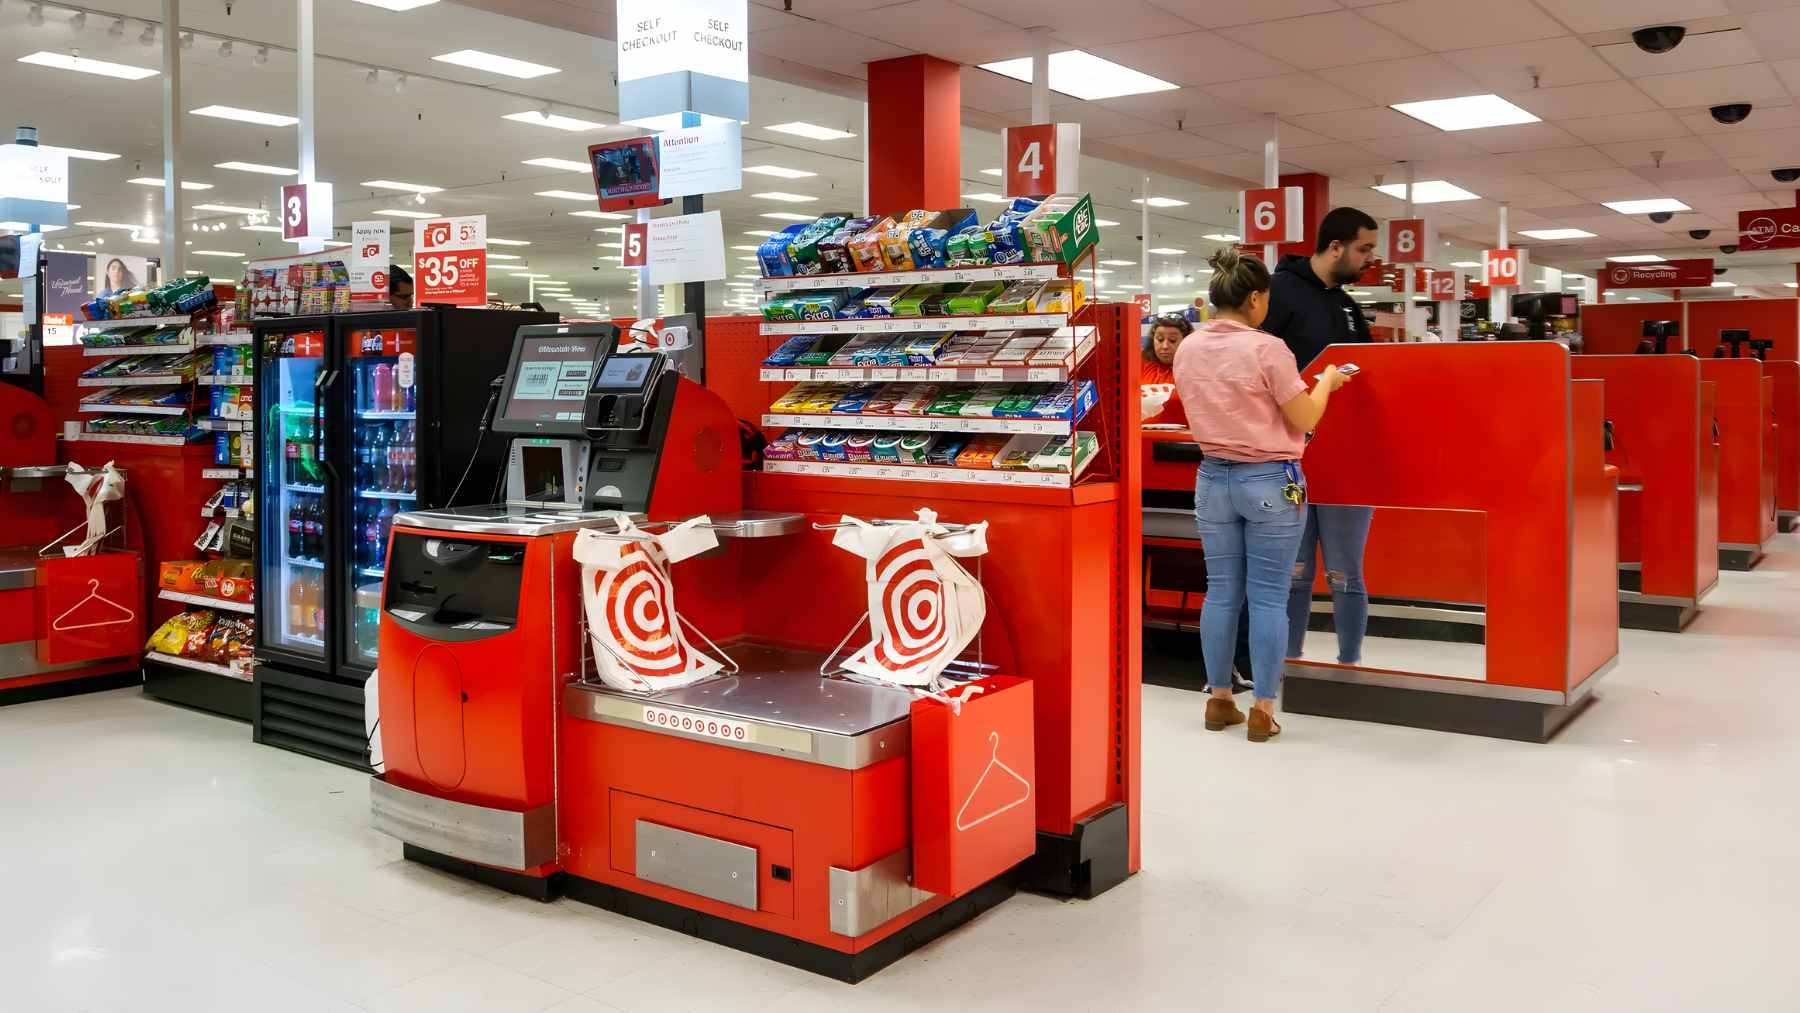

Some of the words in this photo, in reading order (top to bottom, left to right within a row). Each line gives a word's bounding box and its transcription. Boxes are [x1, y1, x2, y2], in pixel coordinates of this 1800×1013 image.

[637, 17, 661, 33] SELF
[707, 18, 729, 33] SELF
[622, 30, 677, 52] CHECKOUT
[693, 31, 743, 52] CHECKOUT
[663, 135, 699, 148] Attention
[1018, 141, 1044, 180] 4
[288, 196, 301, 227] 3
[1255, 201, 1276, 231] 6
[628, 233, 641, 257] 5
[1397, 229, 1415, 253] 8
[419, 255, 459, 287] $35
[460, 258, 480, 269] OFF
[1488, 257, 1517, 278] 10
[1632, 270, 1678, 281] Recycling
[1432, 278, 1455, 295] 12
